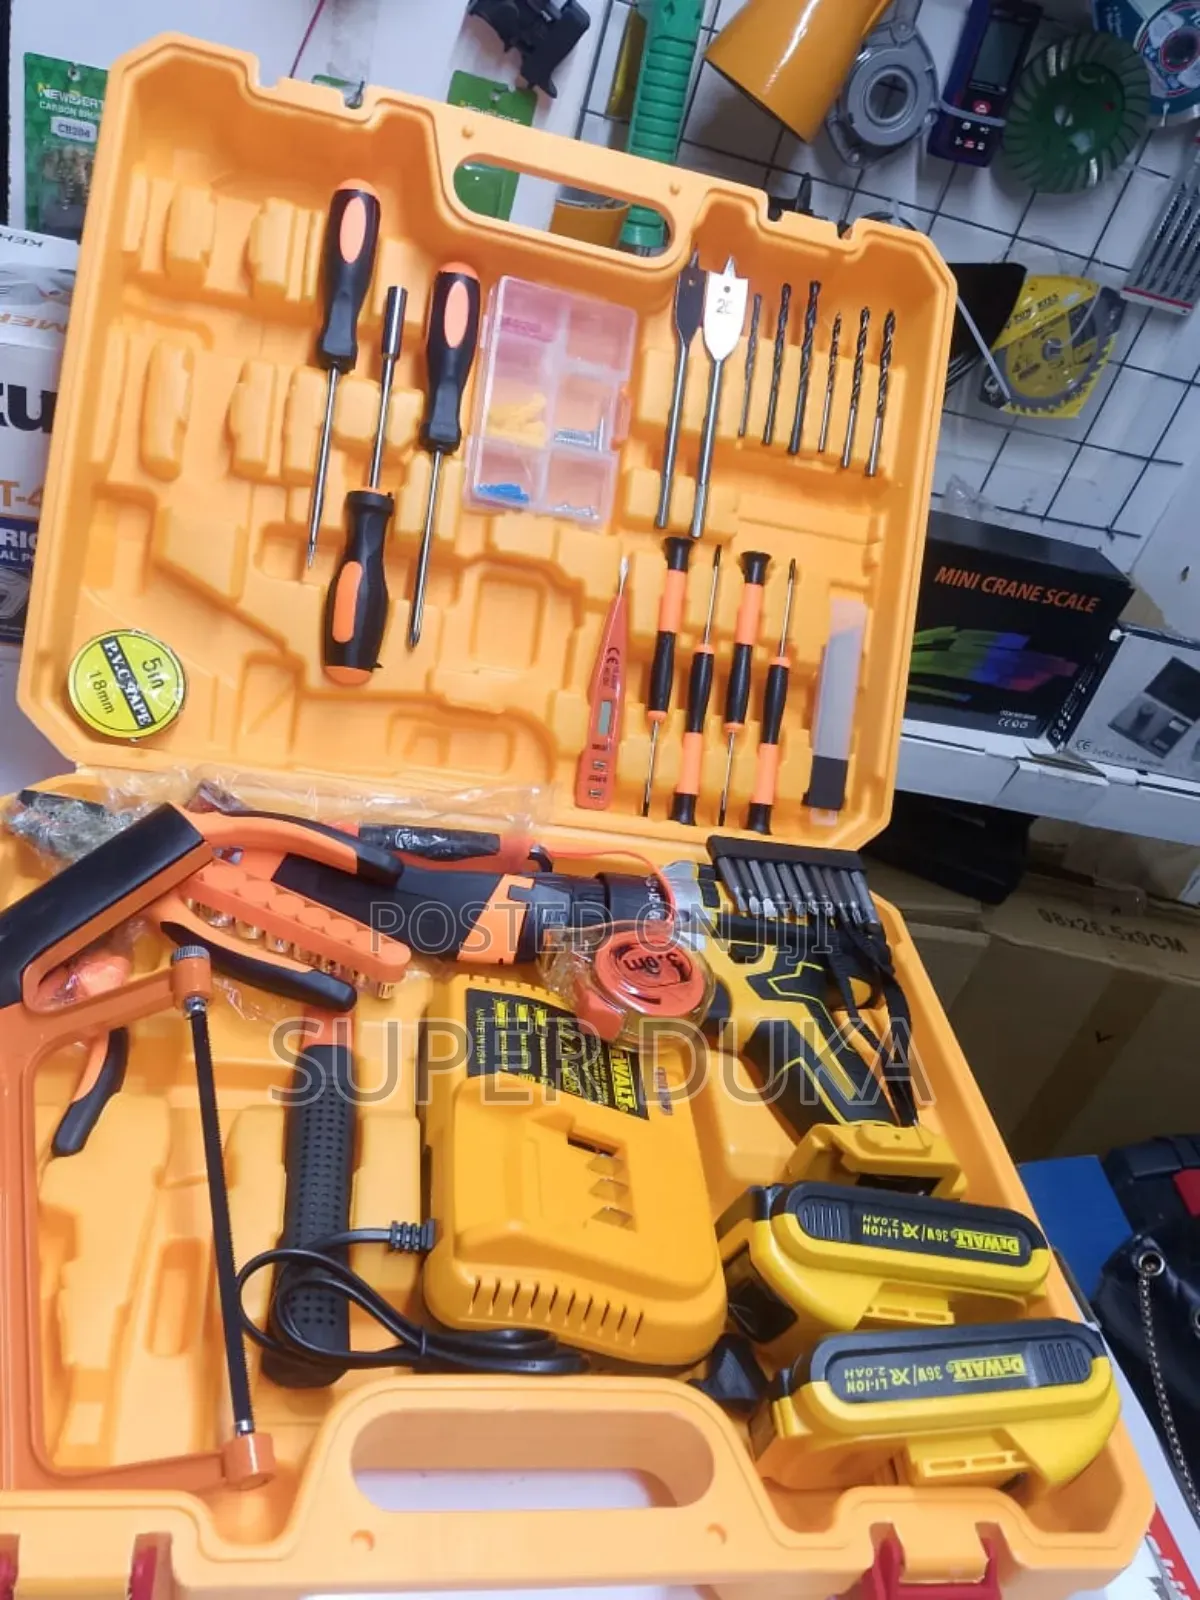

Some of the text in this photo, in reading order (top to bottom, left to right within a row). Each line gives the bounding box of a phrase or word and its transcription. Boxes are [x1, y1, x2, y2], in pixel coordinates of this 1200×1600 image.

[934, 565, 1100, 613] MINI CRANE SCALE
[89, 670, 115, 715] 18mm
[476, 1045, 486, 1064] USA
